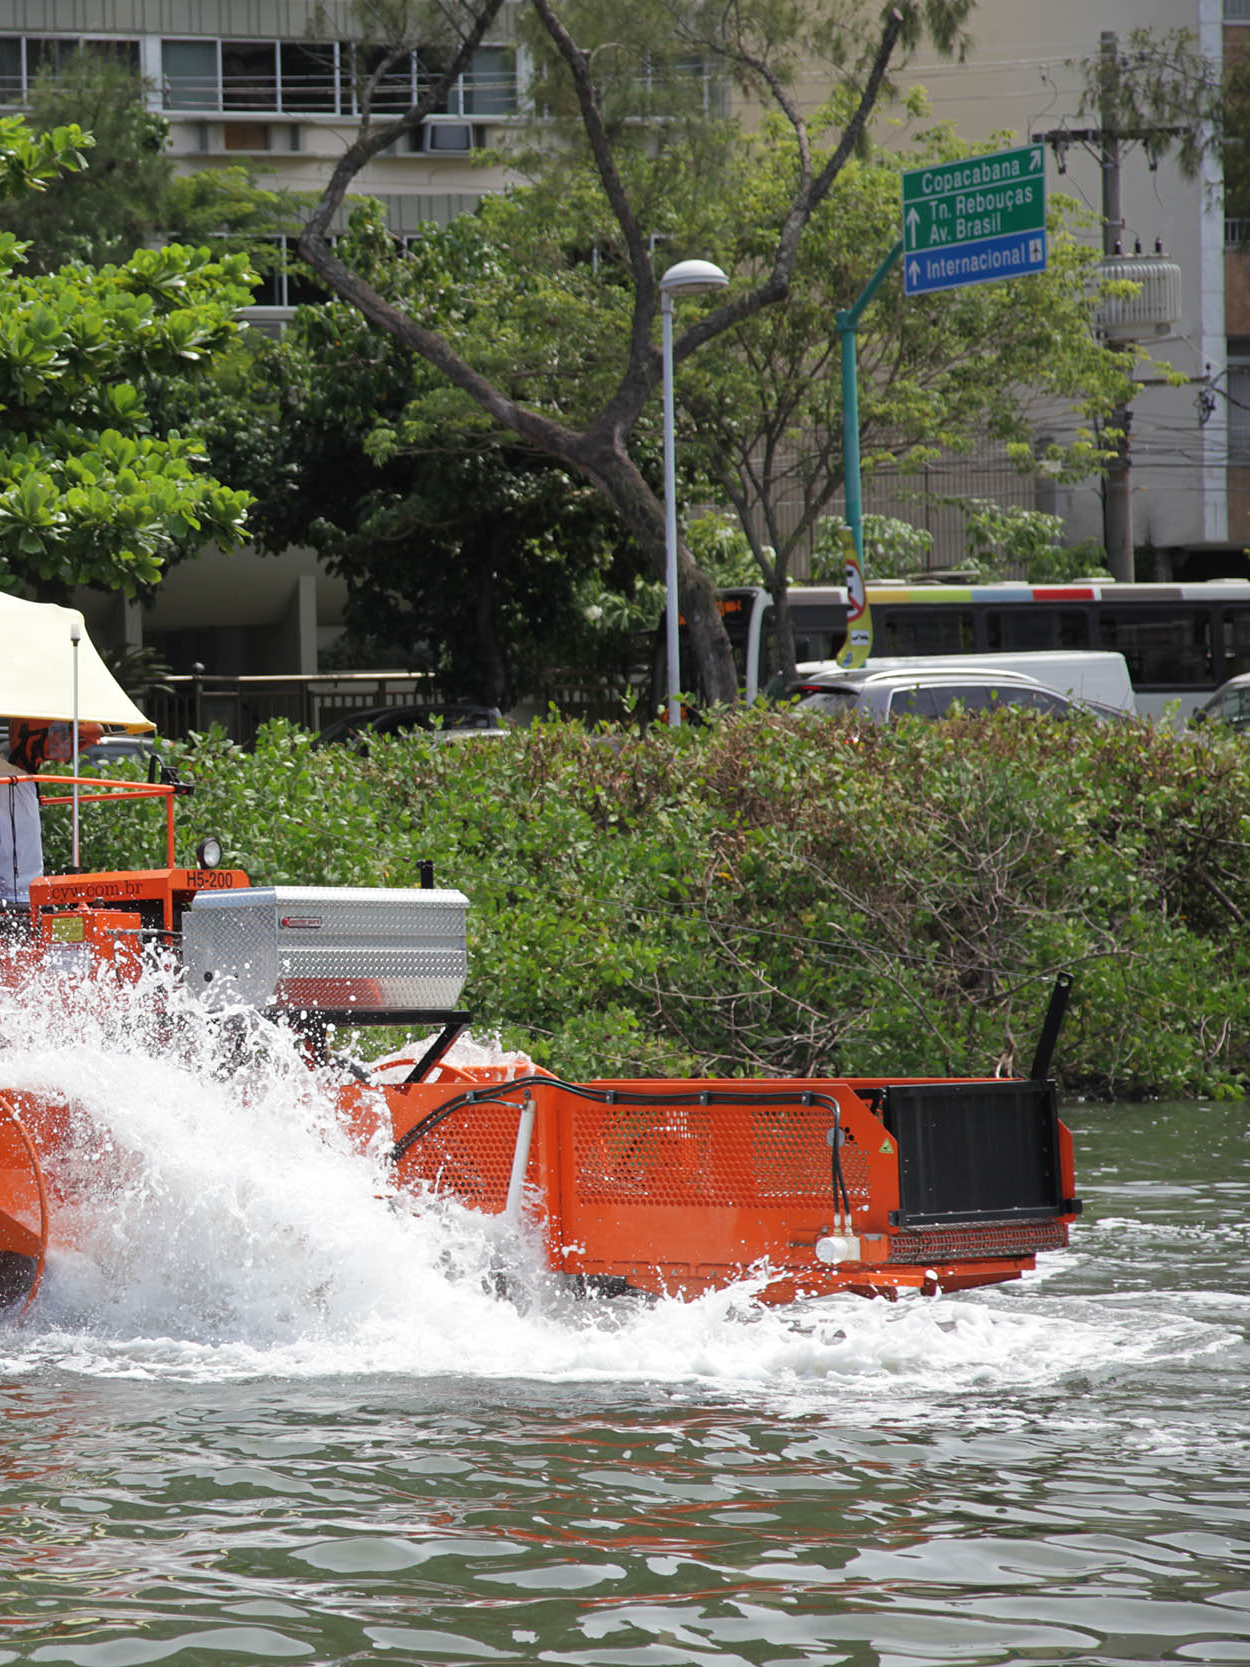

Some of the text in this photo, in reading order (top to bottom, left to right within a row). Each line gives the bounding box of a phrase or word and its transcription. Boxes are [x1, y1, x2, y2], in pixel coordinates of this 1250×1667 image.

[922, 159, 1020, 194] Copacabana
[929, 186, 1033, 220] Tn. Rebouças
[930, 212, 1001, 245] Av. Brasil
[927, 244, 1025, 280] Internacional
[52, 880, 143, 901] cyw.com.br
[187, 871, 233, 889] H5-200
